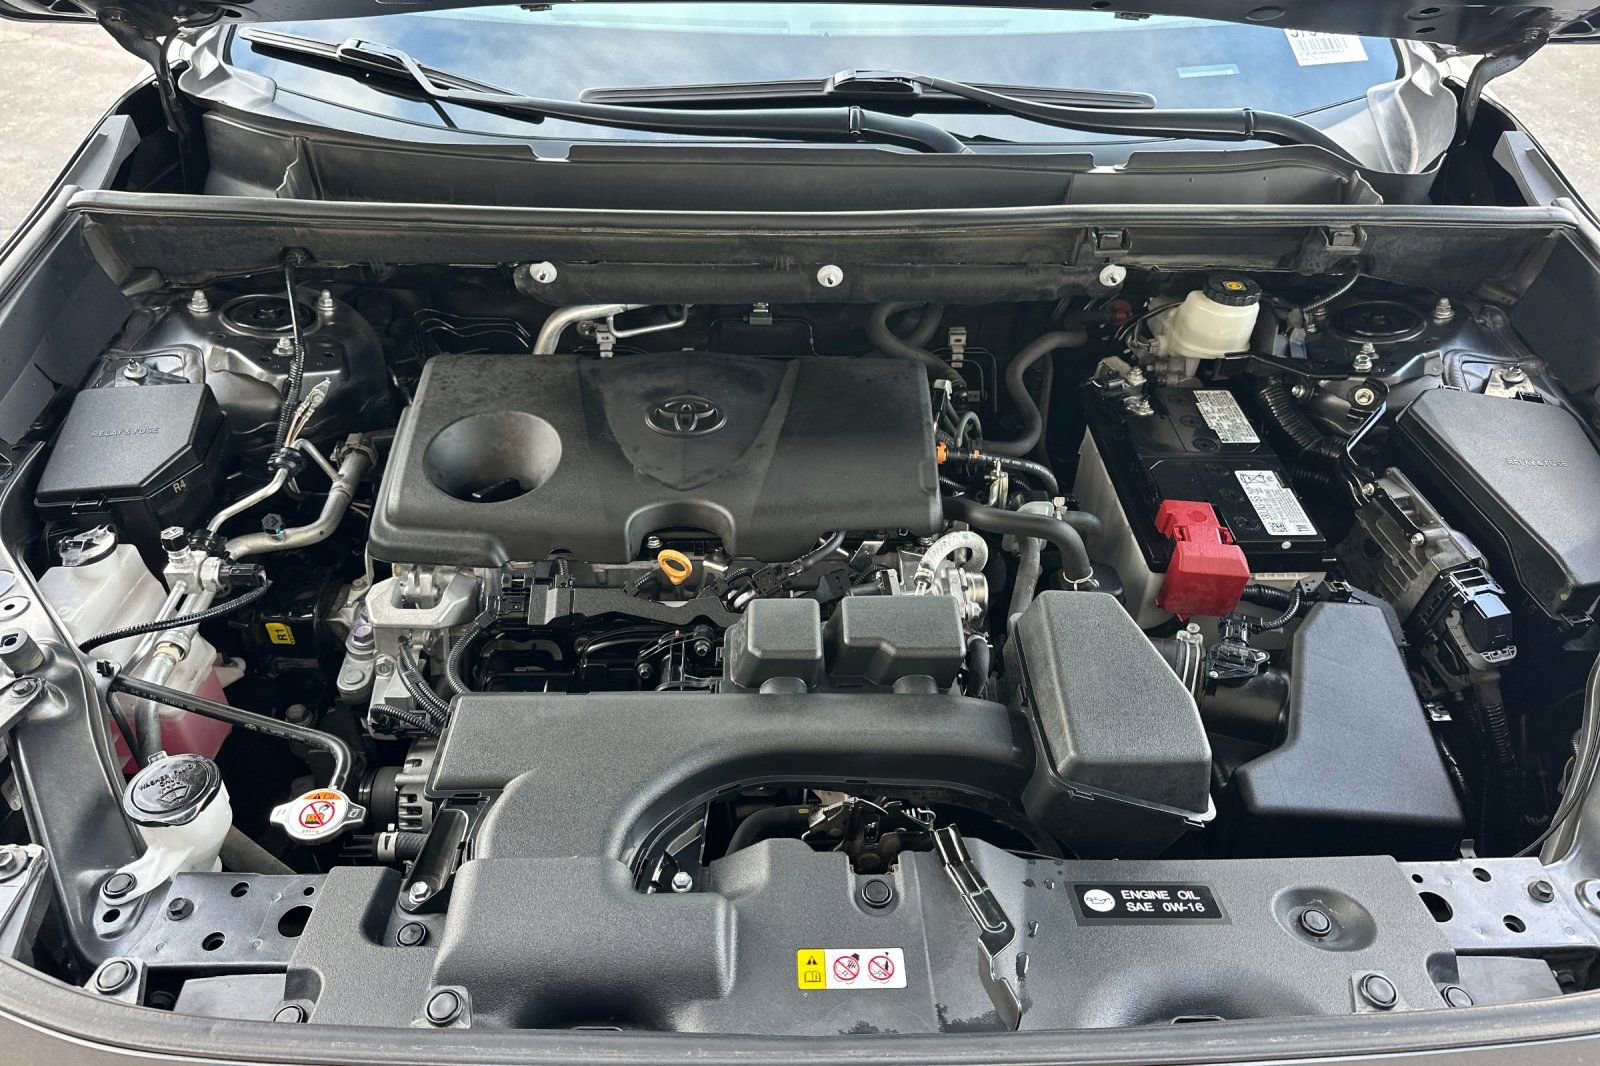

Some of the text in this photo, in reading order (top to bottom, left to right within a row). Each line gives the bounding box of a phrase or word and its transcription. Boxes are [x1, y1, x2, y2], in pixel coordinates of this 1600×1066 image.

[91, 429, 125, 438] RELAY
[172, 479, 187, 494] R4
[1120, 889, 1201, 900] ENGINE OIL
[1125, 902, 1206, 912] SAE 0W-16
